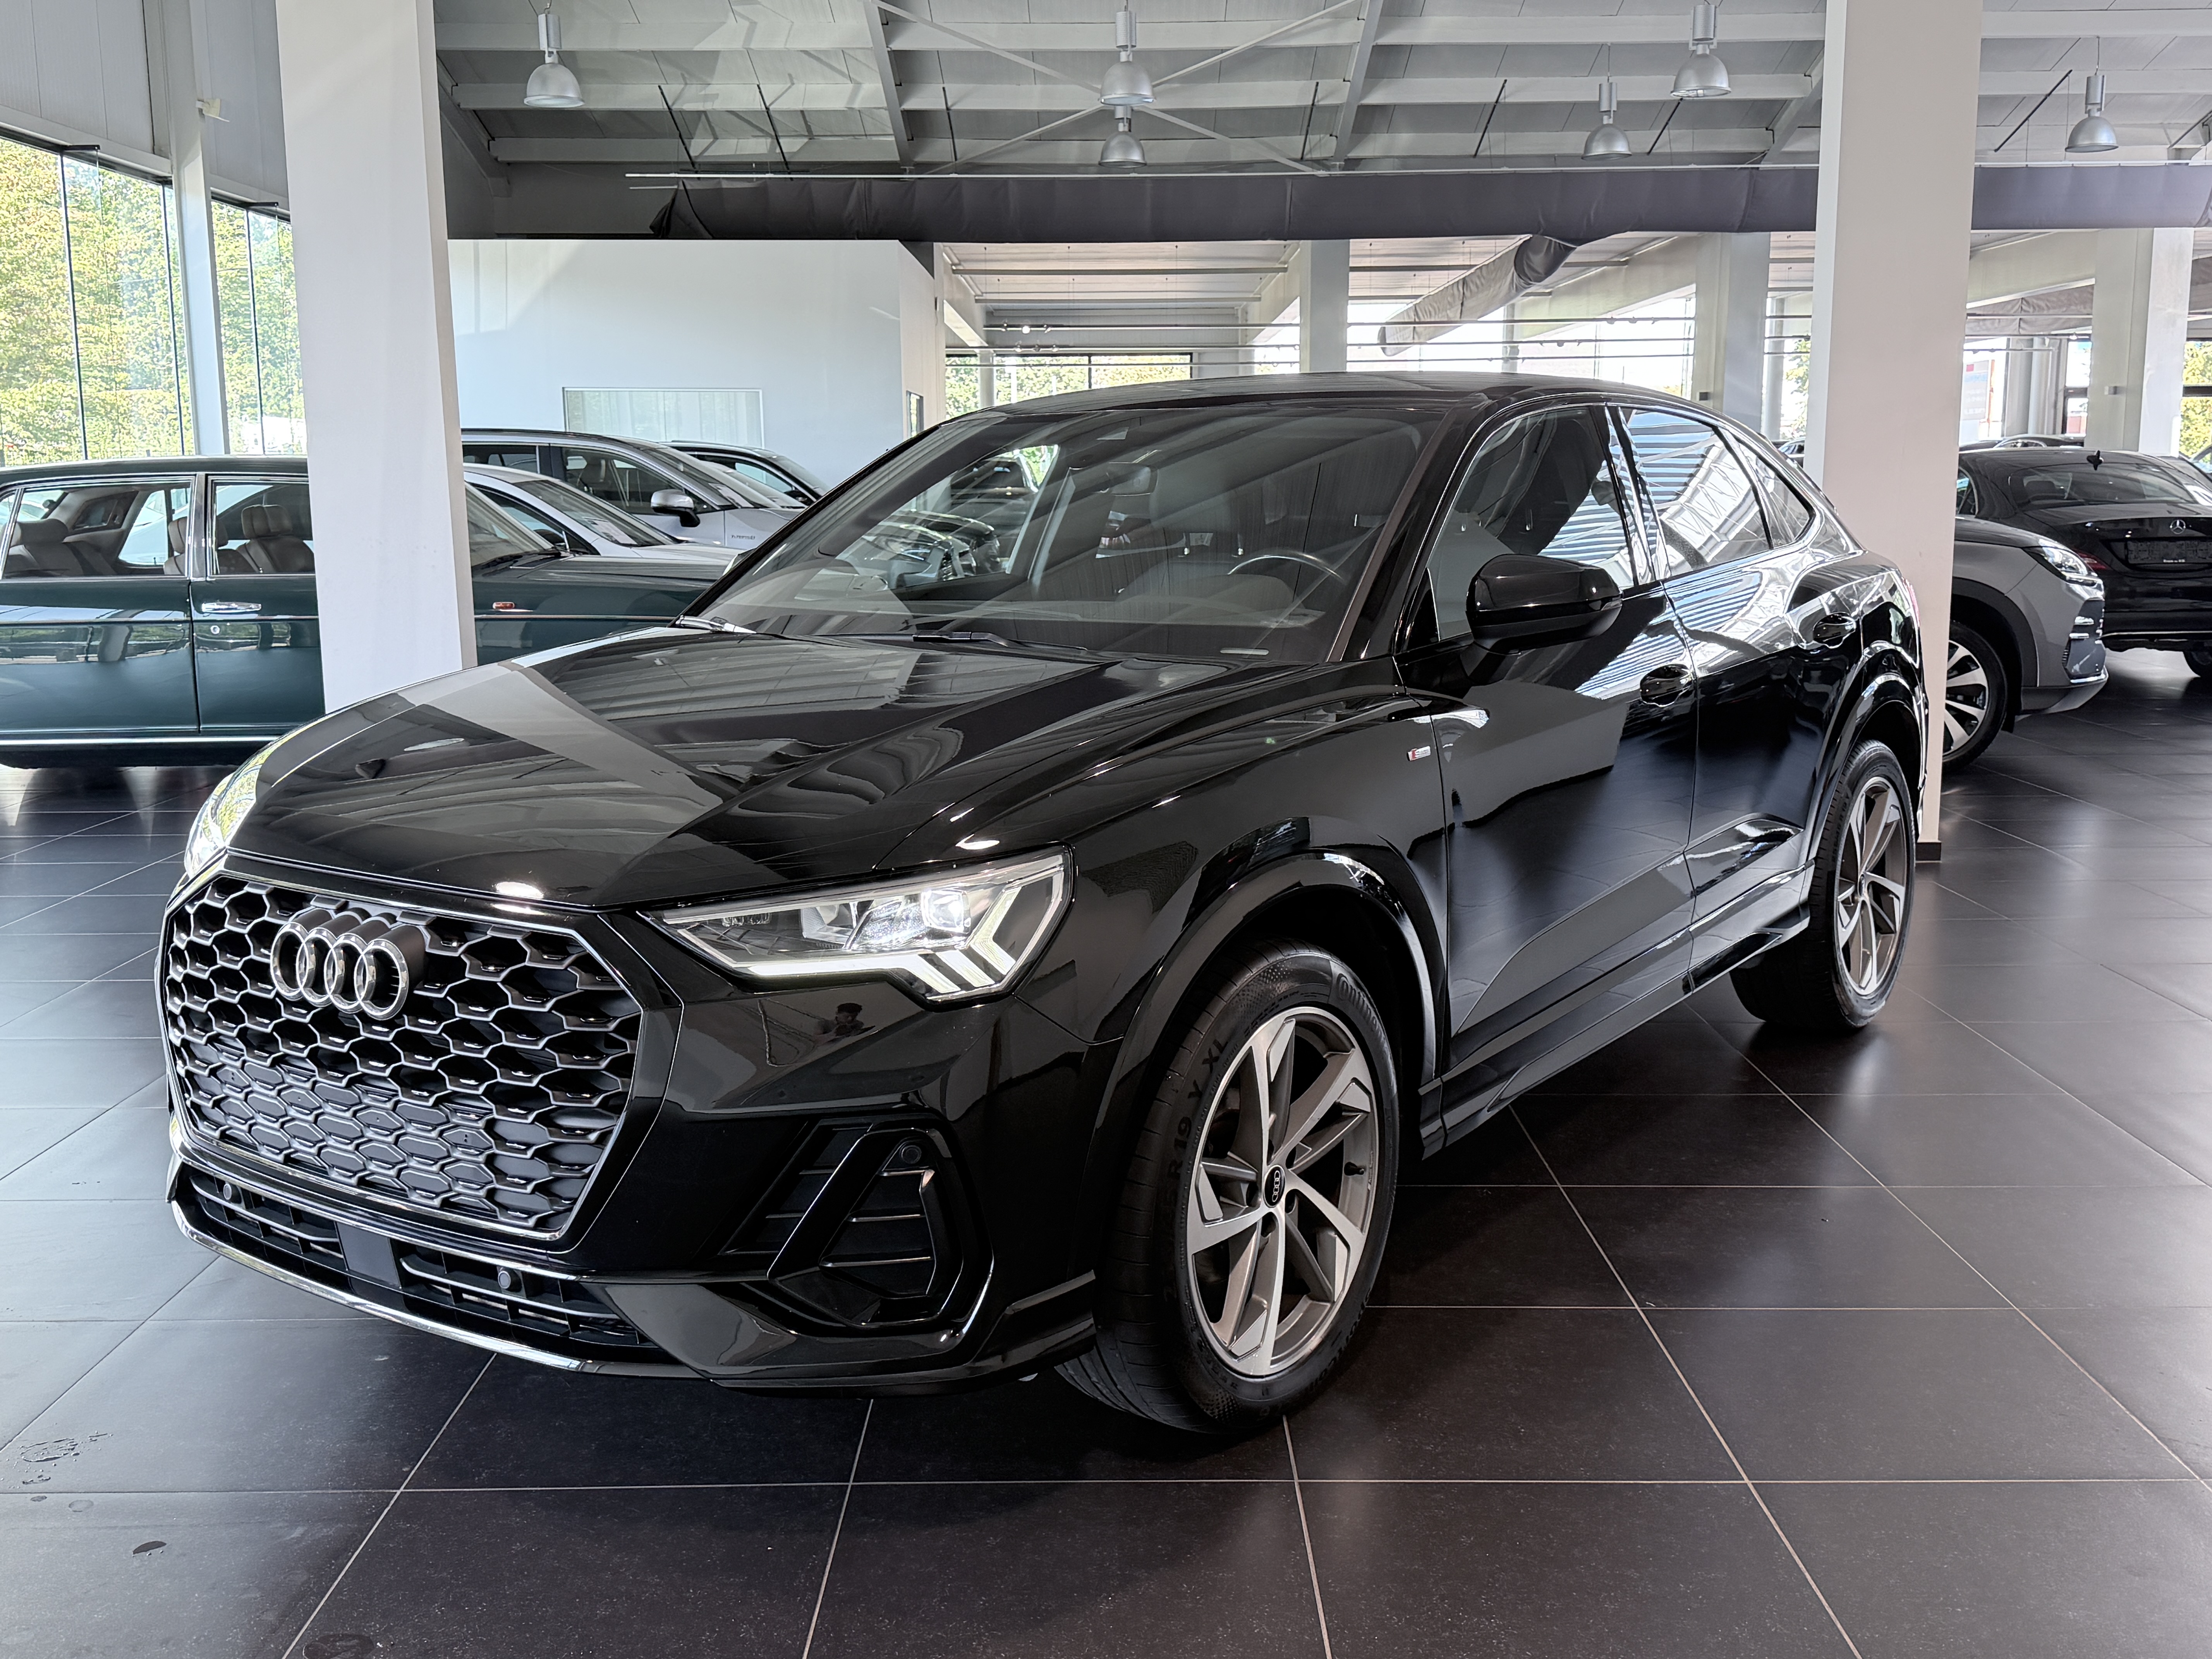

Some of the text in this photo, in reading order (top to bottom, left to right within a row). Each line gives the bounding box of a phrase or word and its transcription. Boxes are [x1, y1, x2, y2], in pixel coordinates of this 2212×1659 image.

[1336, 973, 1389, 1059] Continen
[1202, 1038, 1229, 1073] XL
[1187, 1079, 1203, 1099] Y
[1174, 1116, 1192, 1150] 19
[1168, 1159, 1183, 1180] R
